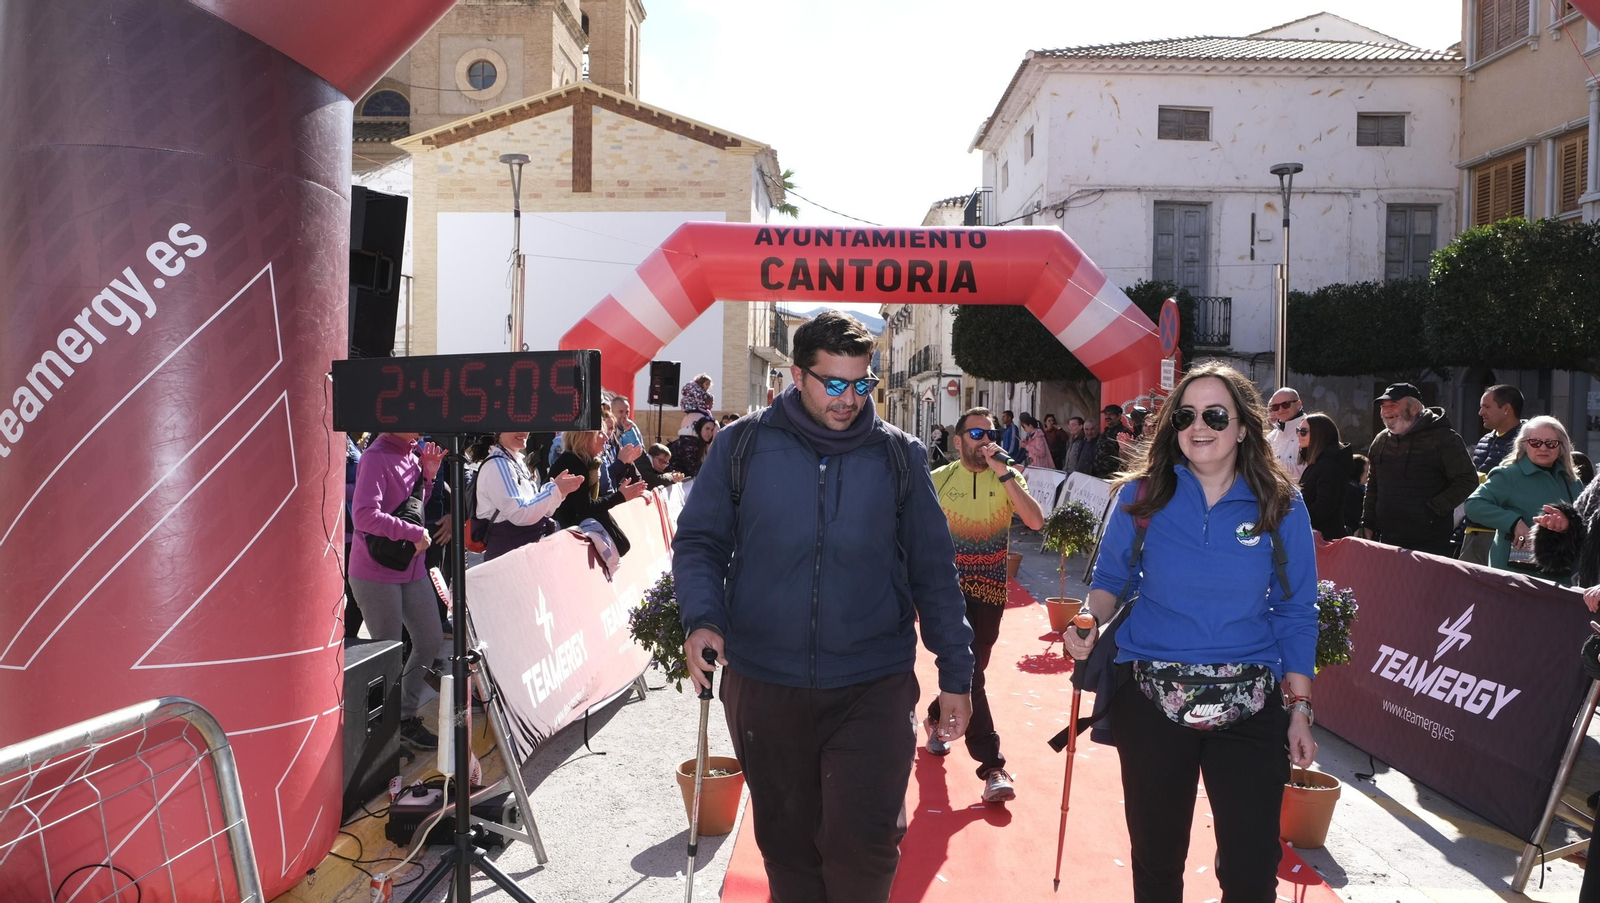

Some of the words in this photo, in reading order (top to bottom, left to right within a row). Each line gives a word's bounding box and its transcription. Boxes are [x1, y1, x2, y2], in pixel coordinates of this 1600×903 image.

[754, 227, 987, 249] AYUNTAMIENTO
[760, 256, 978, 294] CANTORIA
[376, 358, 581, 424] 2:45:05
[521, 629, 588, 709] TEAMERGY
[1370, 643, 1522, 721] TEAMERGY
[1191, 703, 1224, 717] NIKE
[1382, 699, 1456, 742] www.teamergy.es
